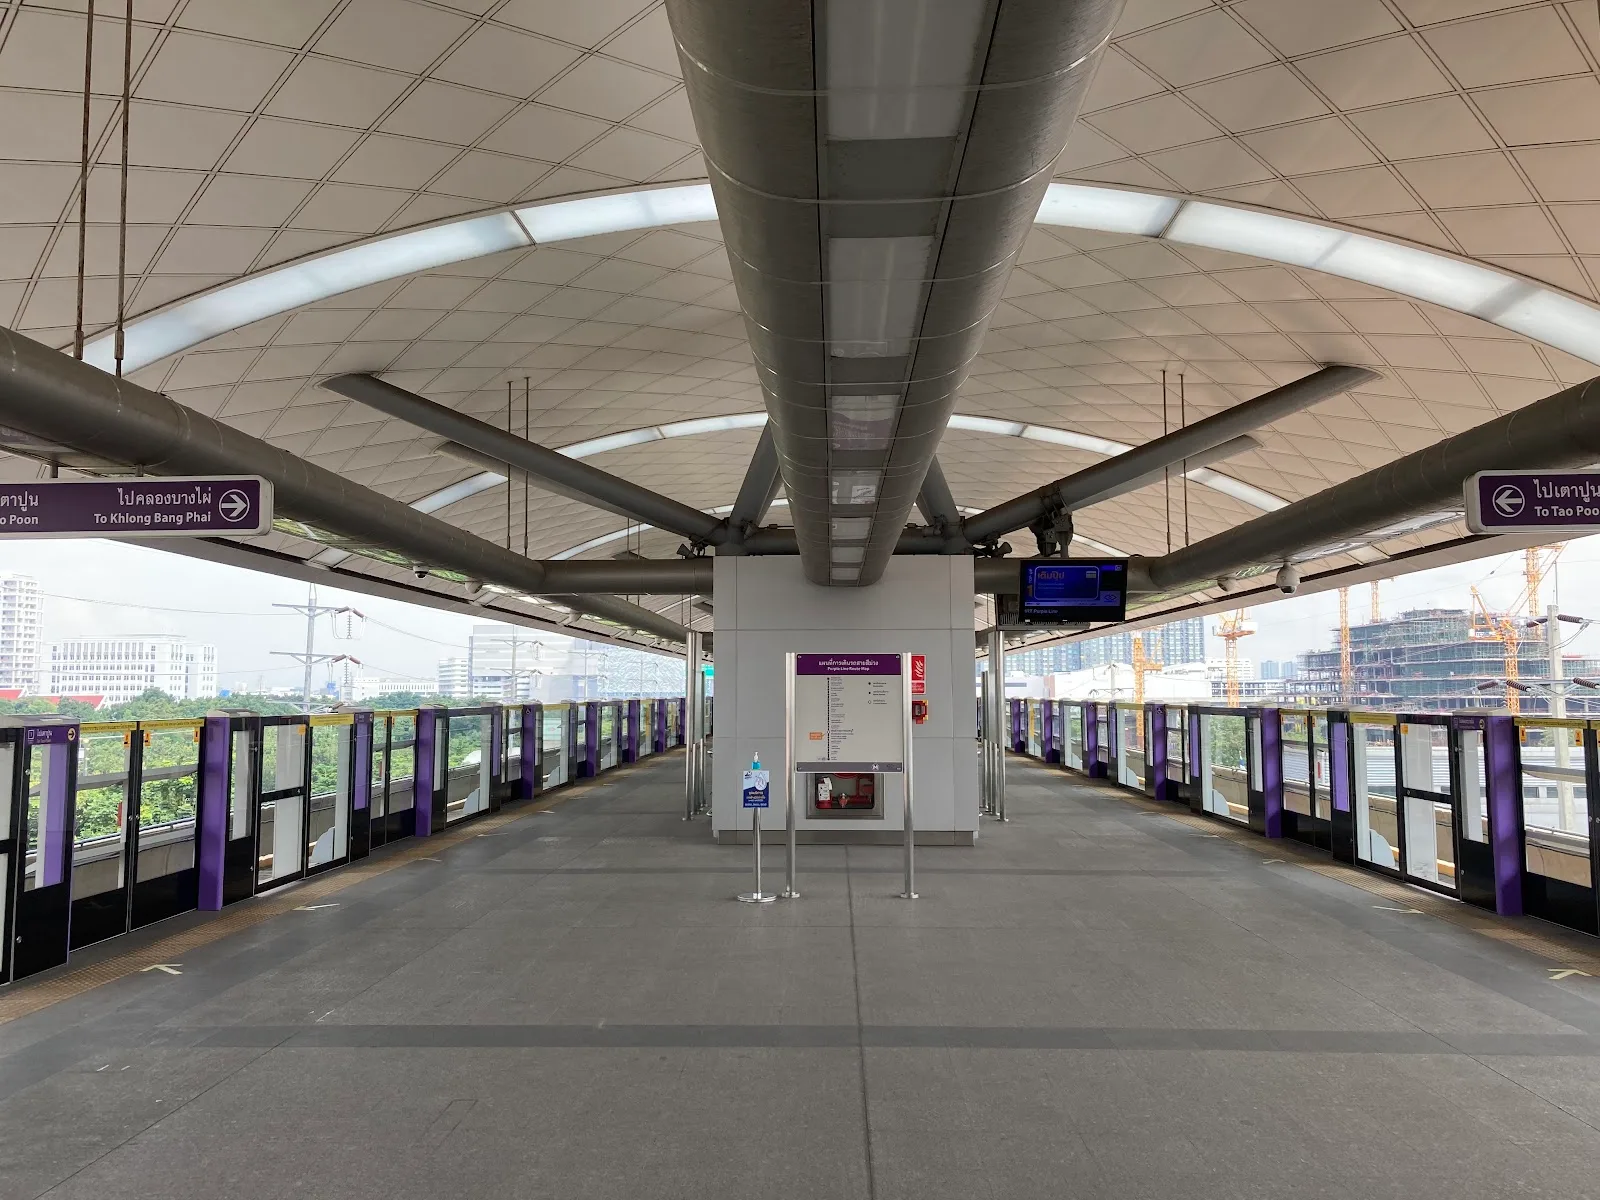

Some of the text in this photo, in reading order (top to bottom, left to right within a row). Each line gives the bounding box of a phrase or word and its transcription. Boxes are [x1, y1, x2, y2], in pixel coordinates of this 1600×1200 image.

[117, 486, 212, 506] ไปคลองบางไผ่
[1534, 506, 1549, 517] To
[1551, 506, 1573, 517] Tao
[9, 514, 39, 525] Poon
[94, 511, 212, 526] To Khlong Bang Phai
